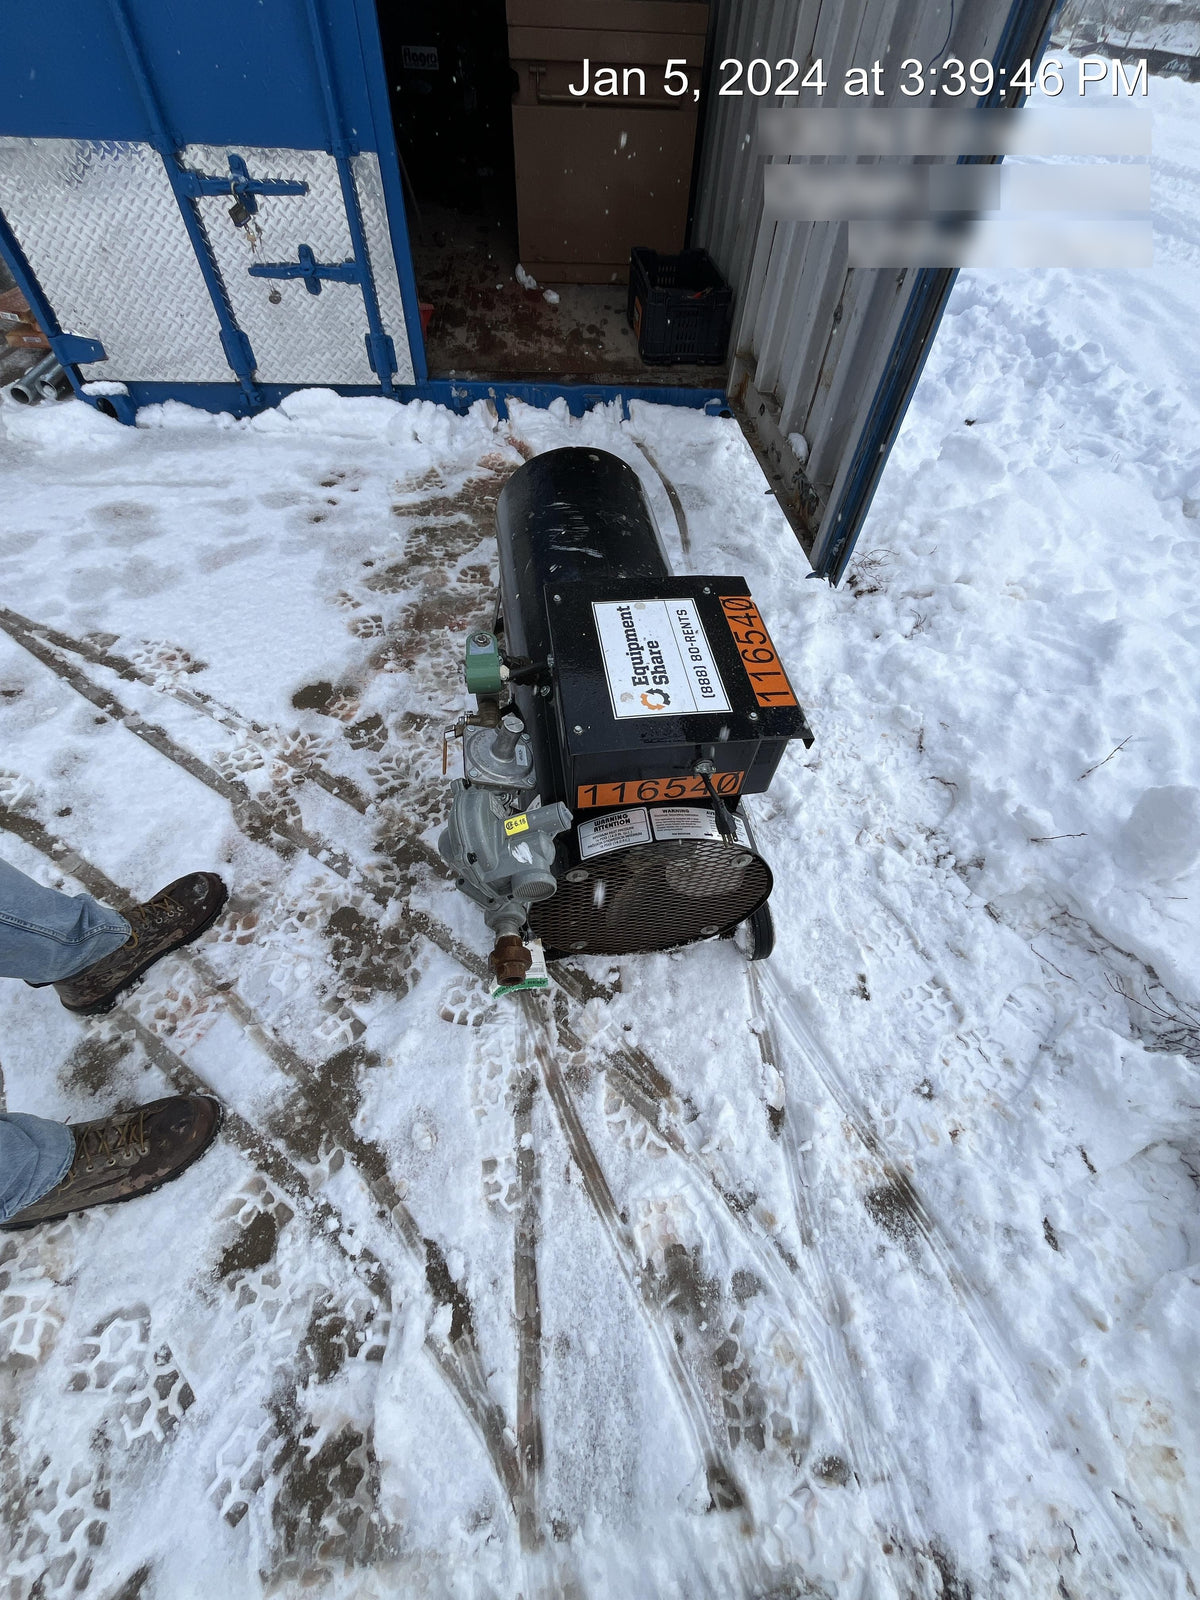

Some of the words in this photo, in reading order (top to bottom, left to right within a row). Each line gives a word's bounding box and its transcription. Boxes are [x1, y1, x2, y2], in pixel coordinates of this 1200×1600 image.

[616, 605, 650, 687] Equipment
[676, 608, 703, 662] 80-RENTS
[721, 597, 790, 703] 116540
[646, 639, 670, 686] Share
[693, 665, 716, 699] (888)
[583, 771, 741, 806] 116540
[593, 813, 629, 827] WARNING
[593, 818, 631, 833] ATTENTION
